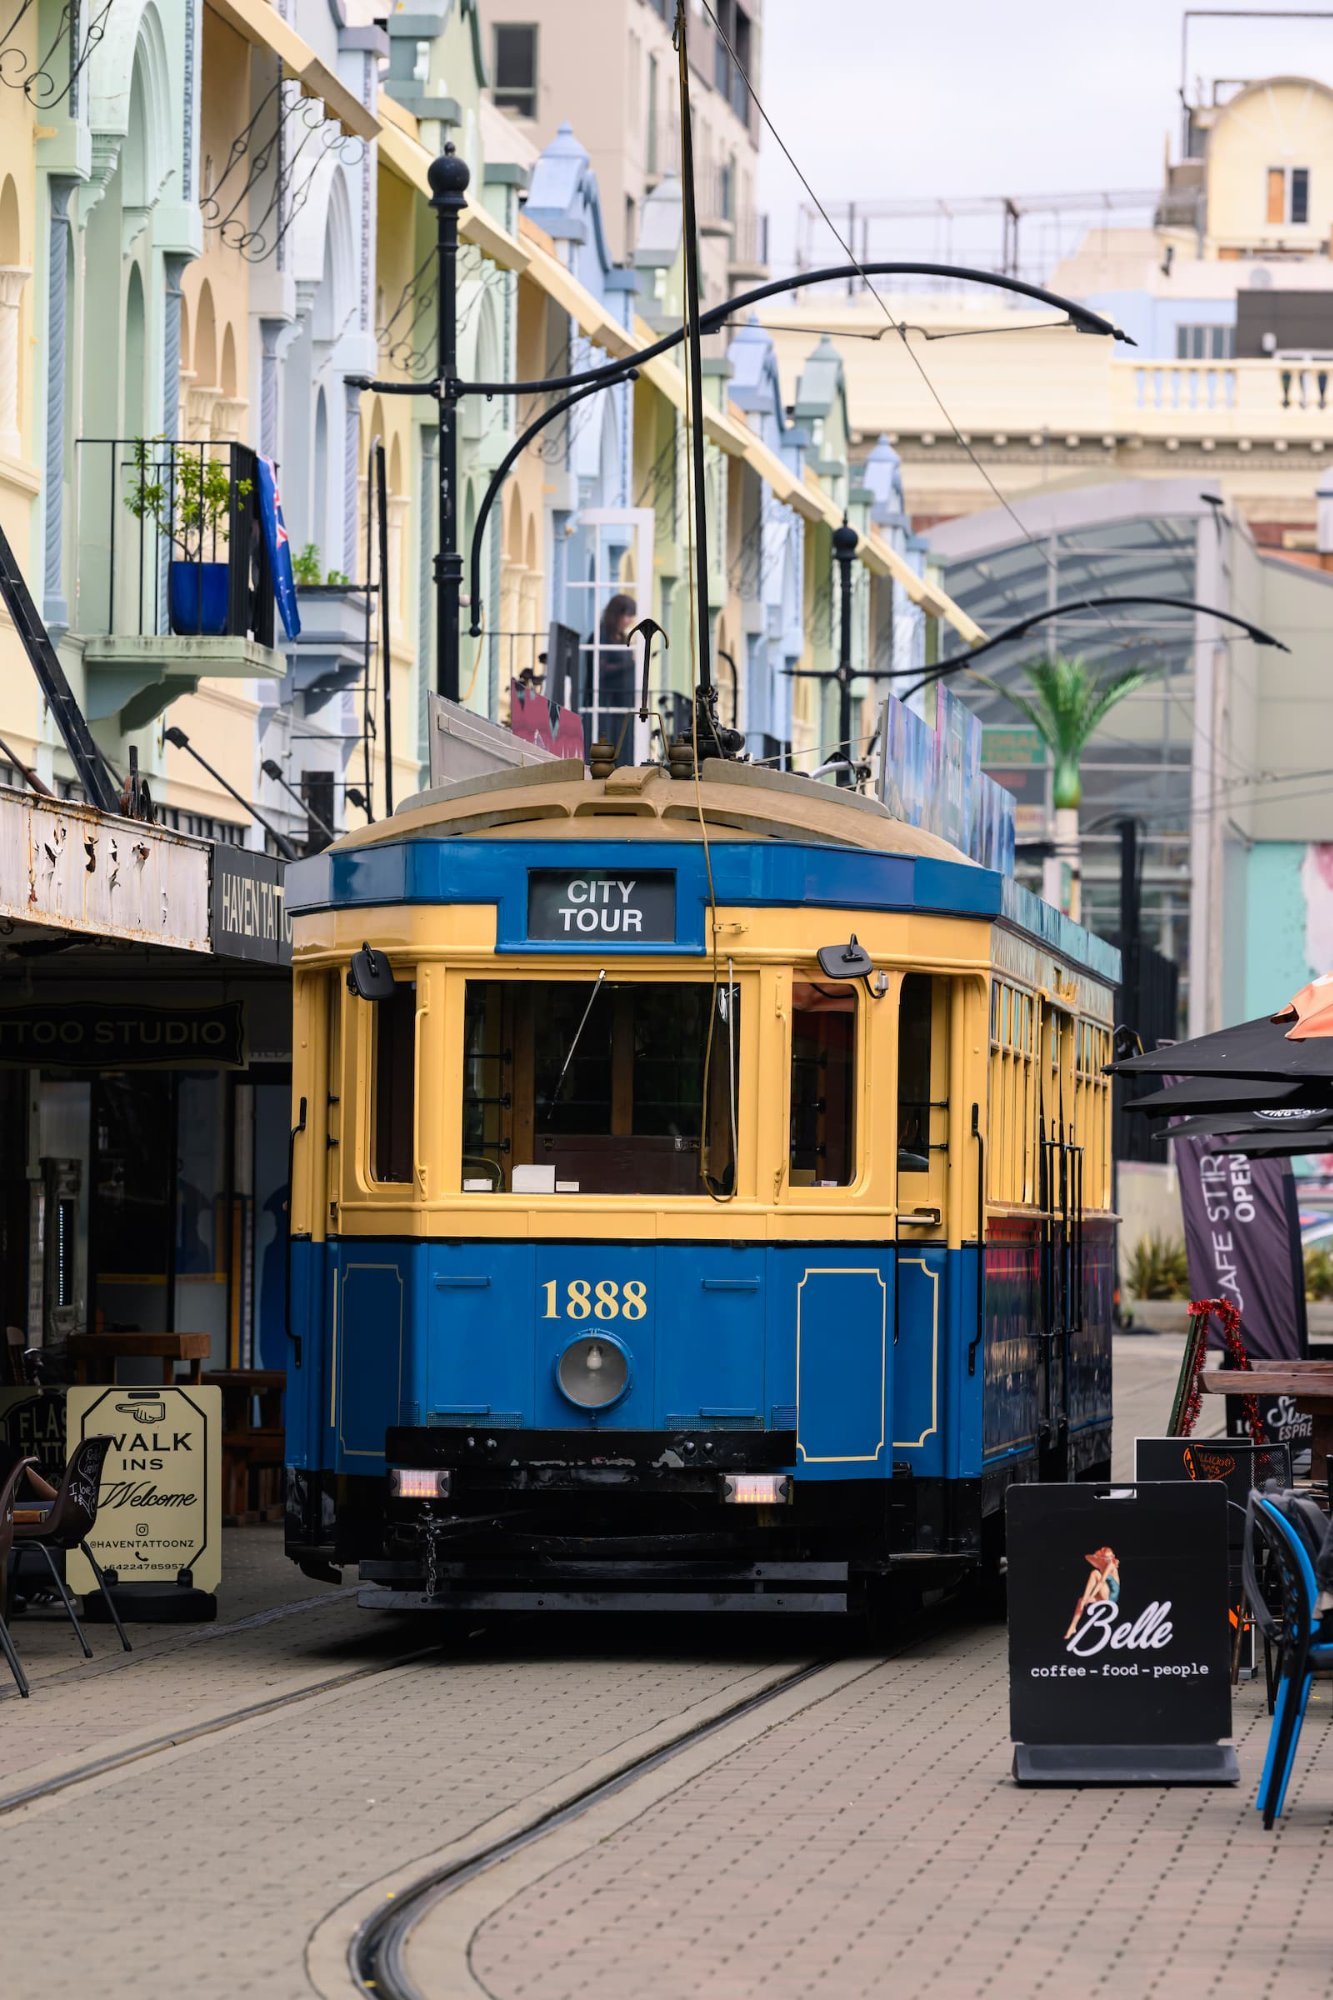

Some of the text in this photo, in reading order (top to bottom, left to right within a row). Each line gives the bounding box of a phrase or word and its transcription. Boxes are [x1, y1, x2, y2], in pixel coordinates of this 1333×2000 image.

[567, 879, 636, 904] CITY
[222, 872, 259, 938] HAVEN
[558, 908, 643, 933] TOUR
[94, 1019, 227, 1045] STUDIO
[1229, 1153, 1256, 1223] OPEN
[540, 1279, 648, 1321] 1888
[122, 1458, 164, 1471] INS
[97, 1481, 198, 1510] Welcome
[90, 1539, 195, 1549] @HAVENTATTOONZ
[1066, 1599, 1174, 1657] Belle
[1031, 1664, 1086, 1678] coffee
[1102, 1663, 1139, 1677] food
[1153, 1662, 1209, 1678] people
